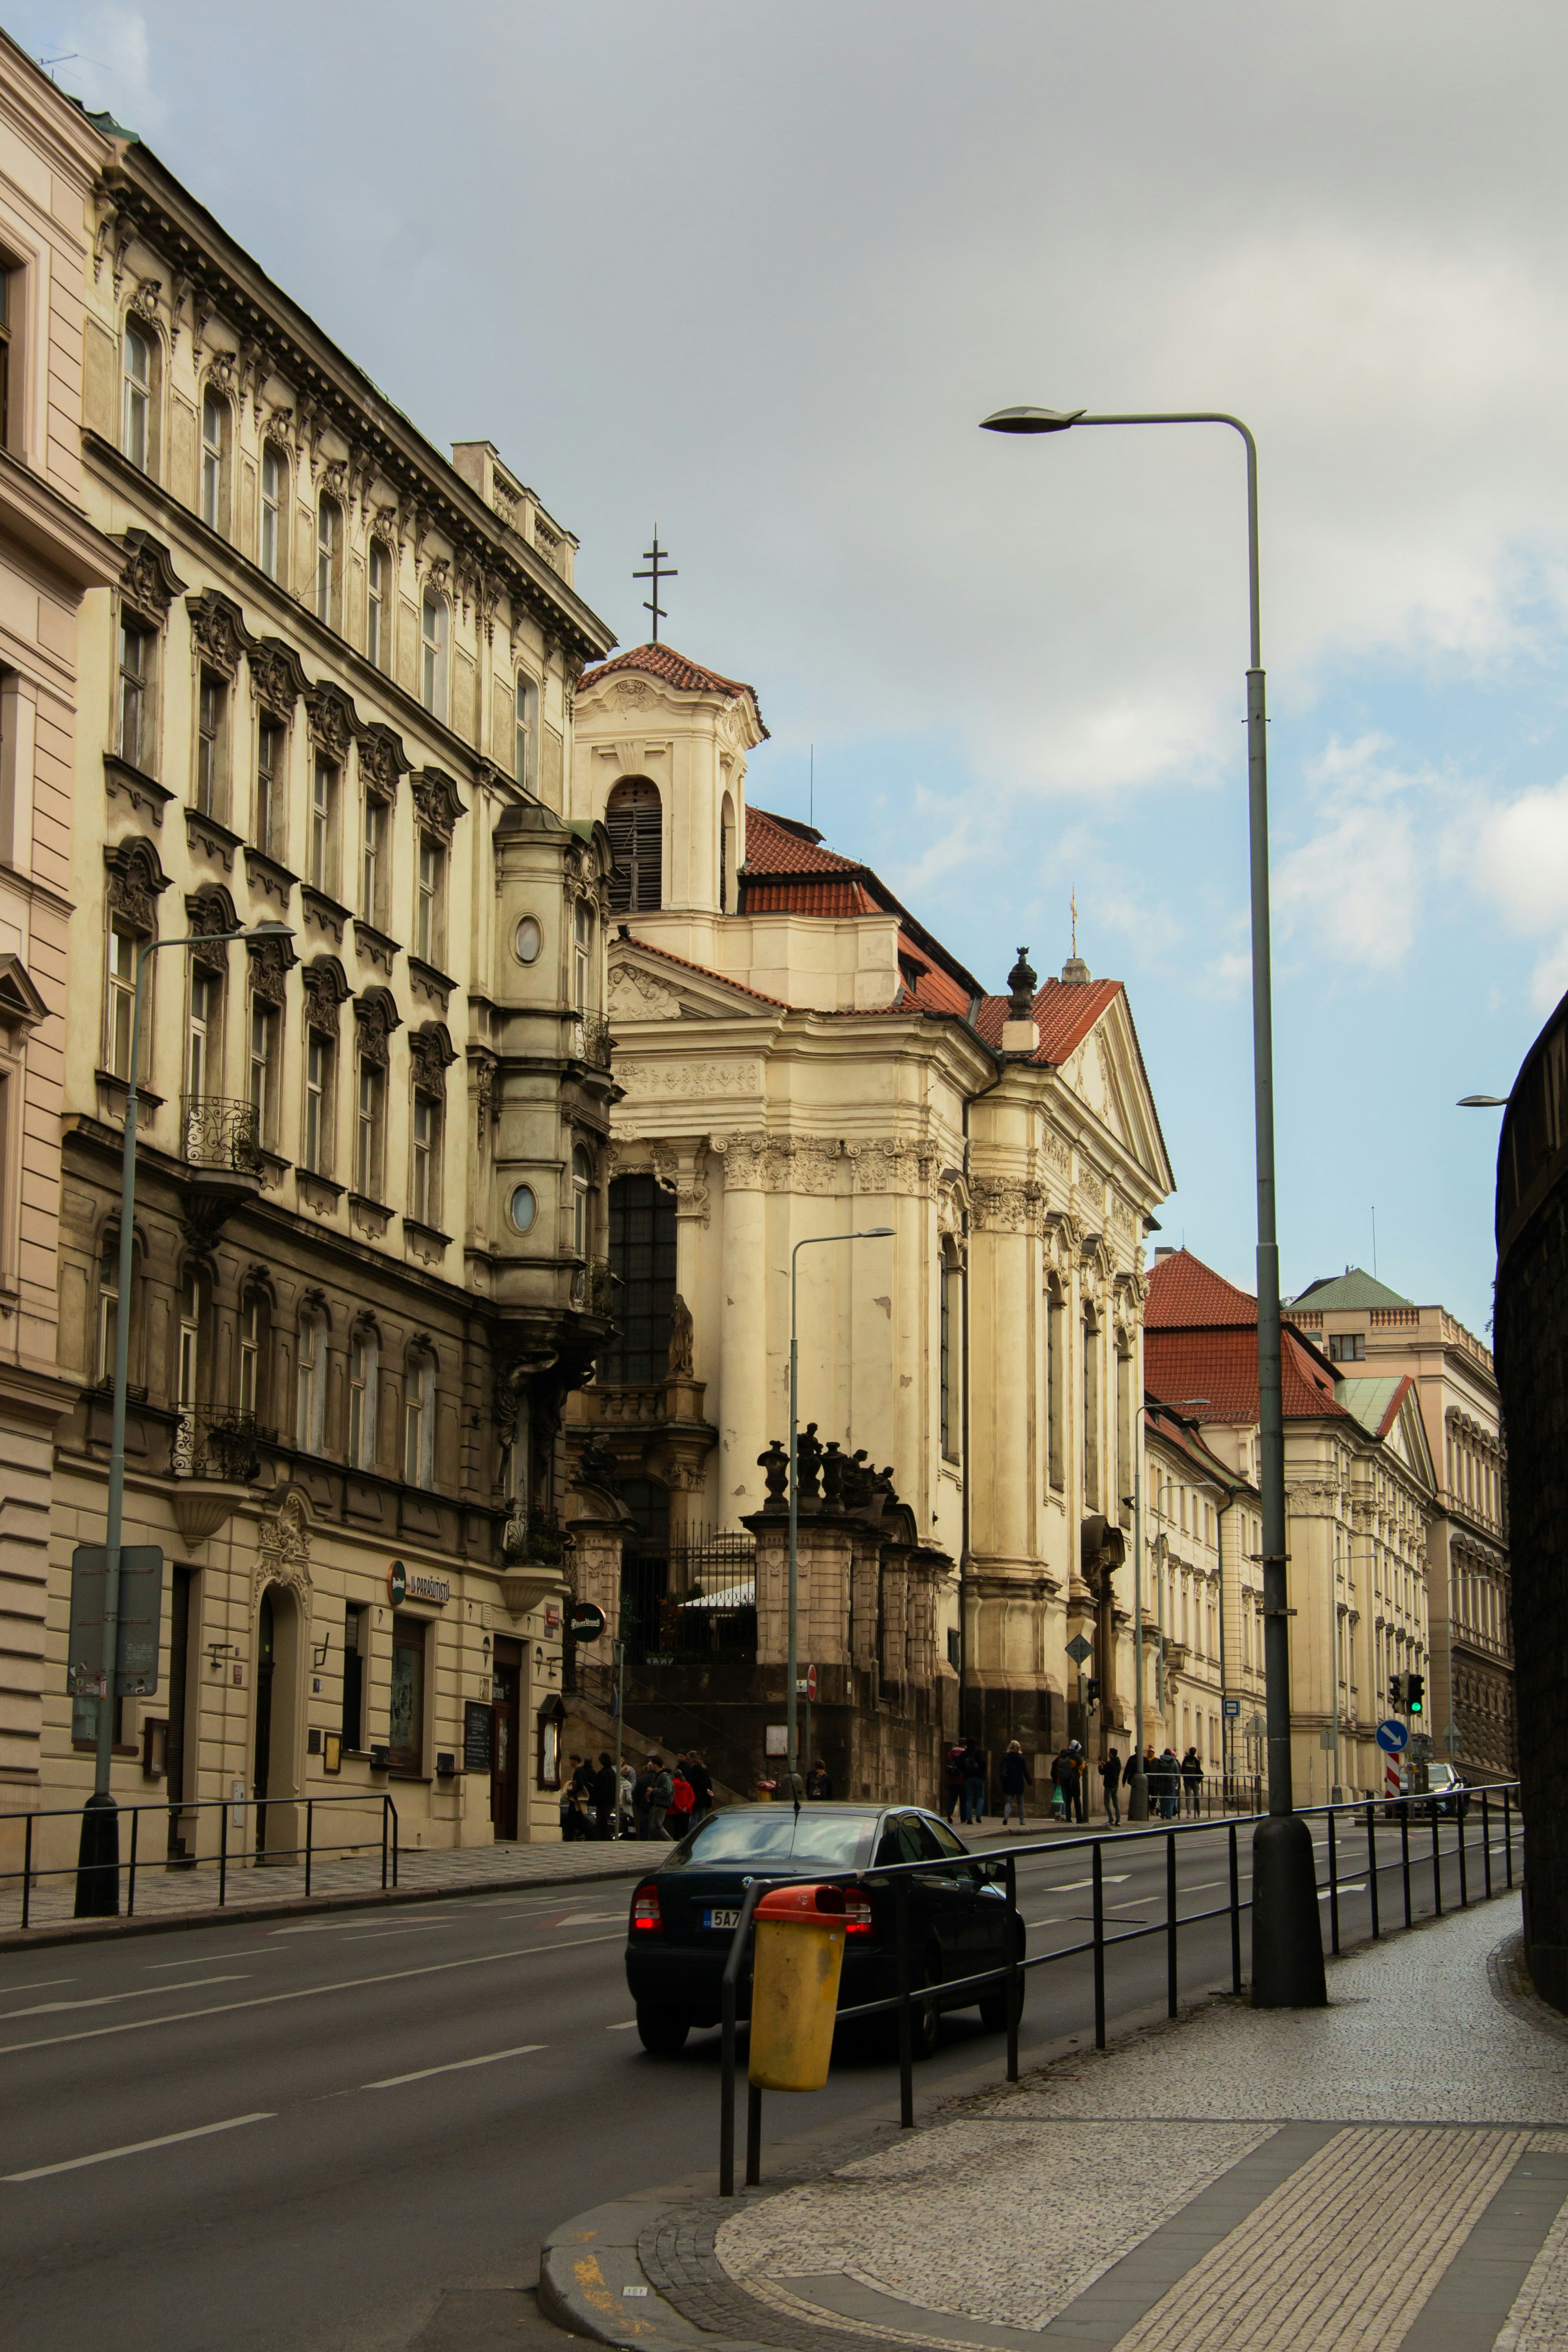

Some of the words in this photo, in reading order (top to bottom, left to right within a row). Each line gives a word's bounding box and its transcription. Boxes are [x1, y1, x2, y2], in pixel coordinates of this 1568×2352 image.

[410, 1575, 415, 1593] U
[571, 1618, 586, 1630] Pilsner
[585, 1618, 600, 1627] Urquell
[714, 1911, 740, 1926] 5A7
